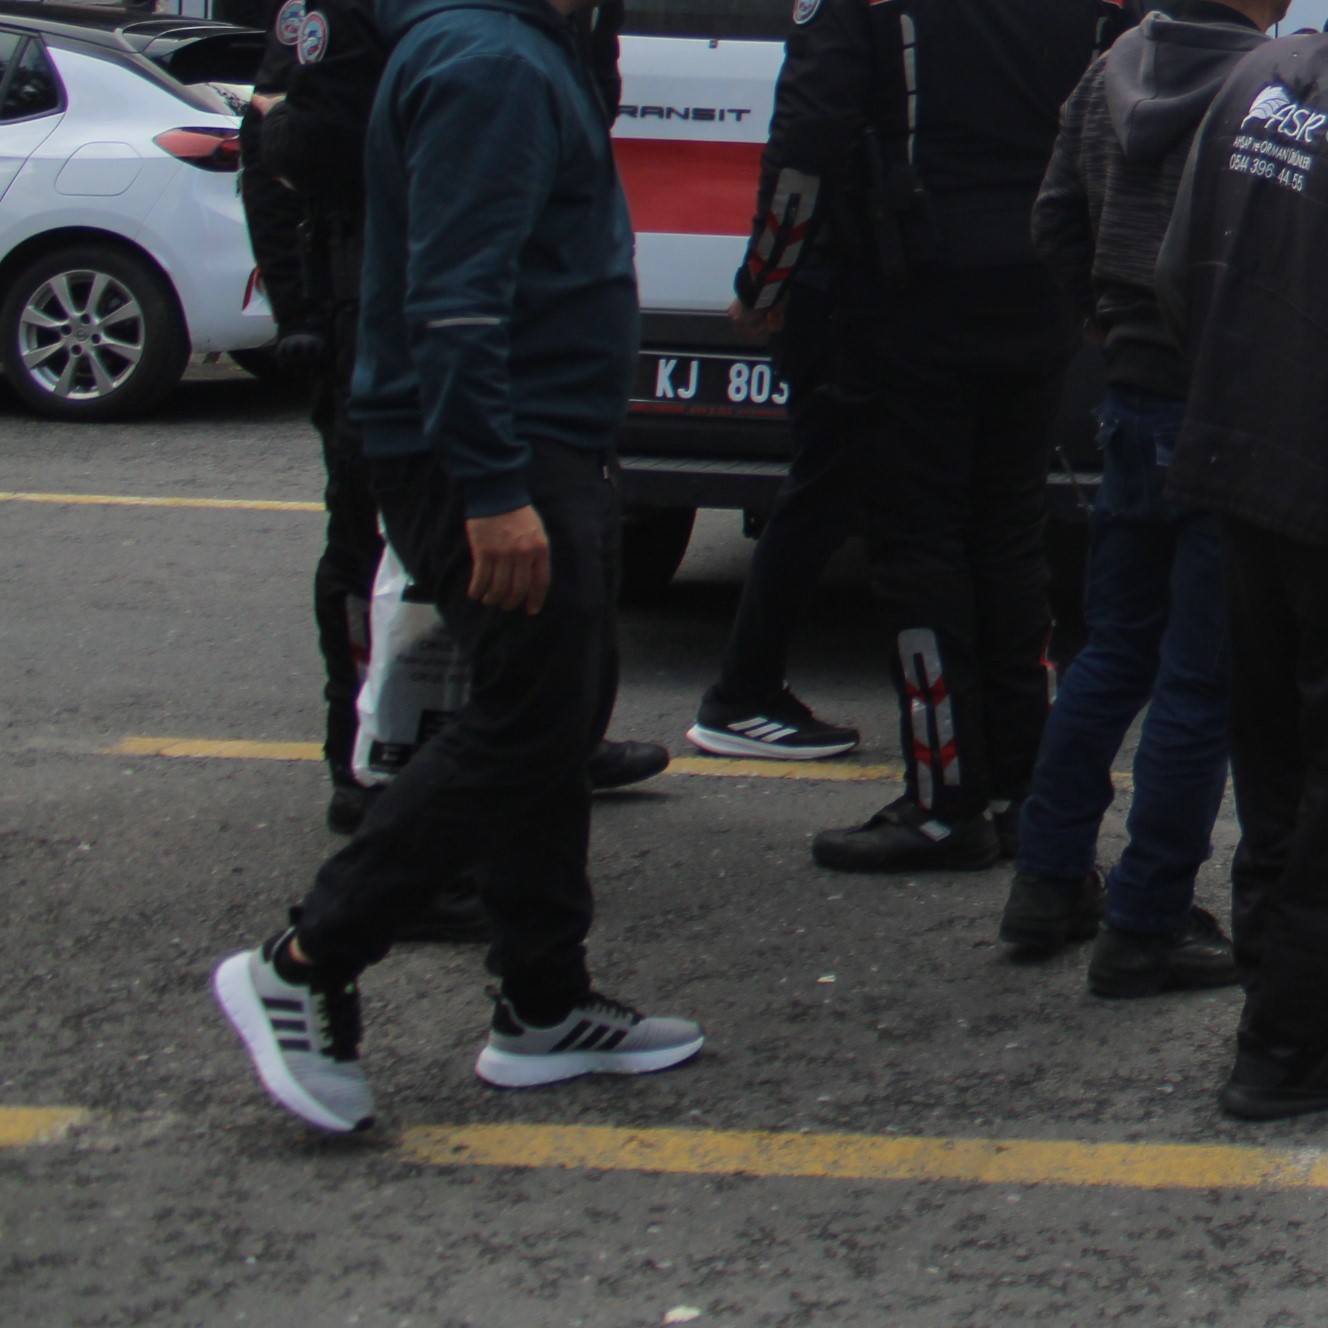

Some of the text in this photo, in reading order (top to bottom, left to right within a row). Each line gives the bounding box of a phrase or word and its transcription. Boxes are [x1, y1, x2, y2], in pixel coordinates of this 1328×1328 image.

[617, 104, 751, 122] RANSIT
[1264, 103, 1327, 143] ASR
[1260, 140, 1286, 161] ORMAN
[1229, 153, 1304, 191] 0544 396 44 55
[655, 358, 700, 400] KJ
